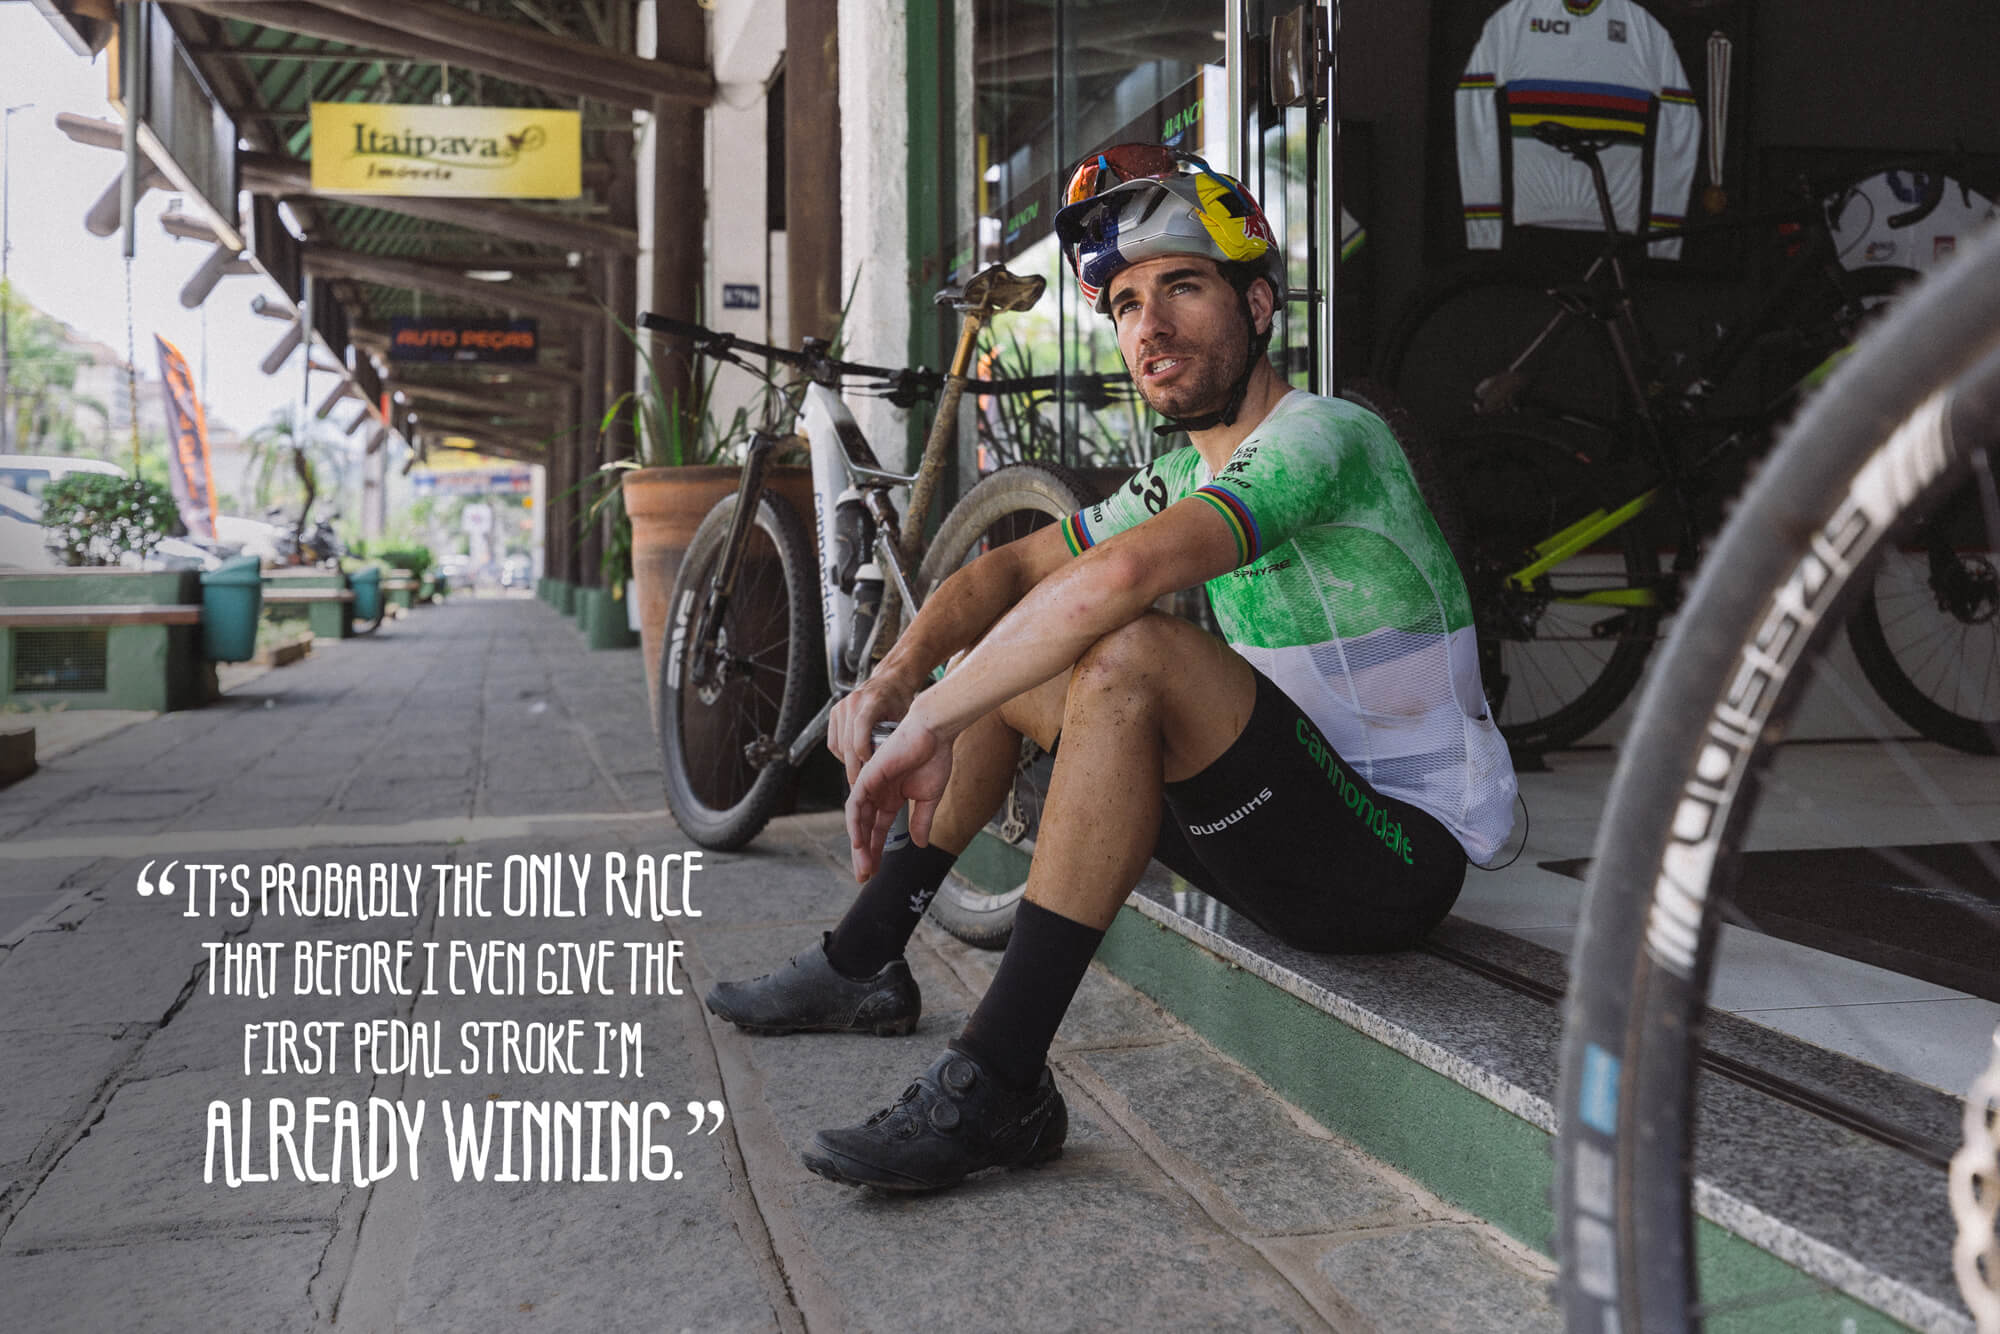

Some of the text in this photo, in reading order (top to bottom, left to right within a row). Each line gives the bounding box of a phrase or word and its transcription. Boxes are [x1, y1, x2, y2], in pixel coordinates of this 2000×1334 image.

[1537, 18, 1571, 36] UCI
[354, 122, 499, 159] Itaipava
[396, 328, 458, 348] AUTO
[1296, 717, 1414, 866] cannondale
[1188, 786, 1273, 837] SHIMANO
